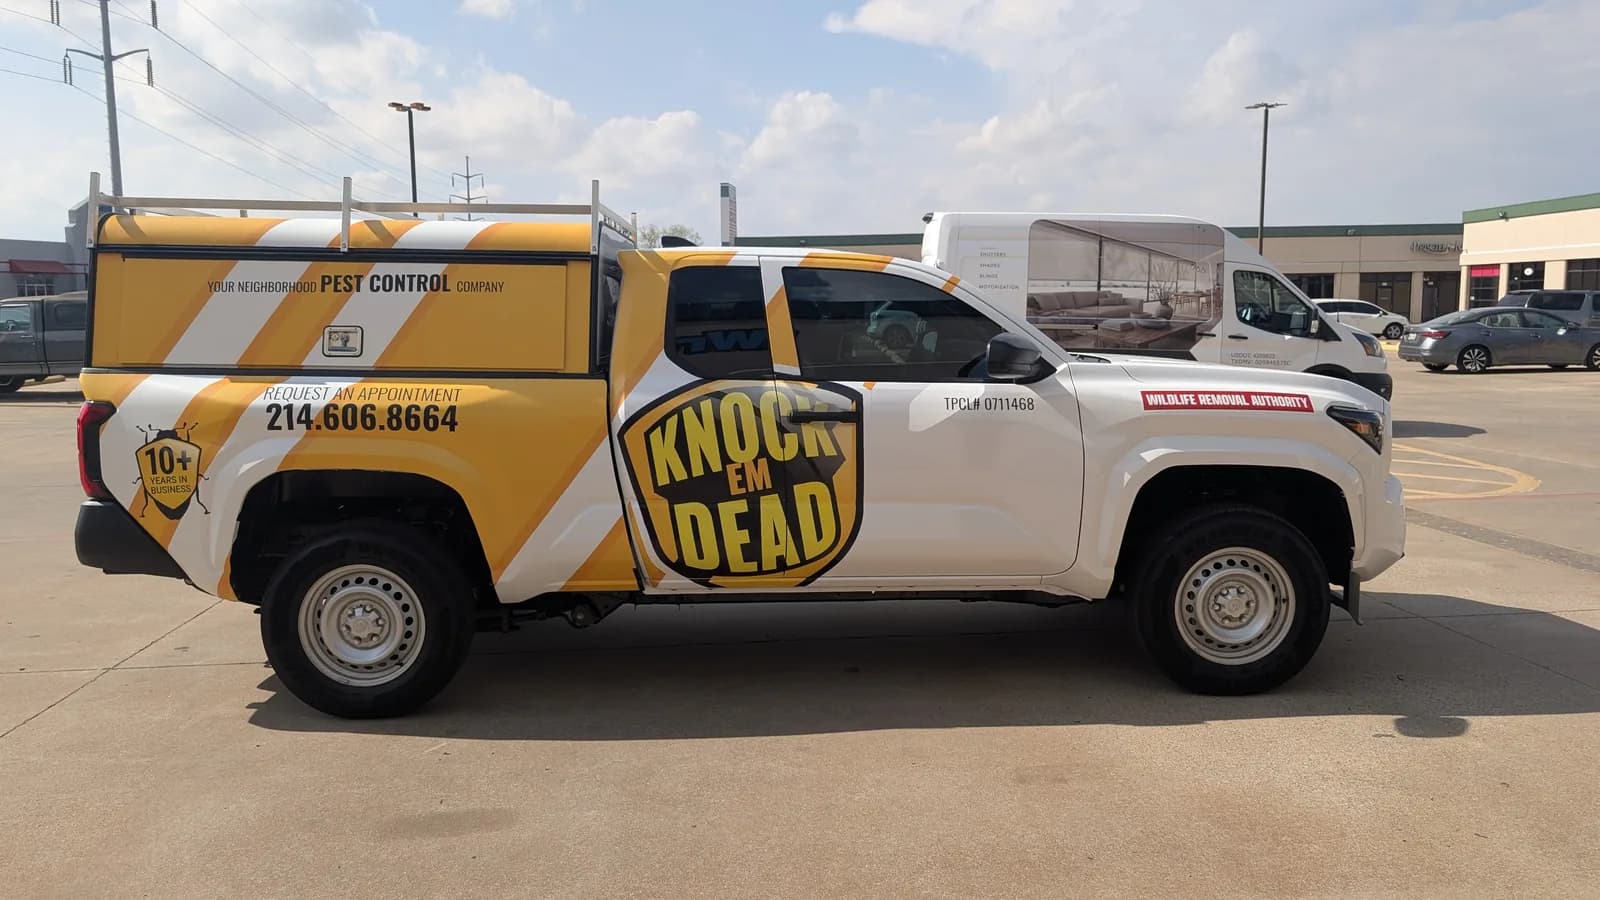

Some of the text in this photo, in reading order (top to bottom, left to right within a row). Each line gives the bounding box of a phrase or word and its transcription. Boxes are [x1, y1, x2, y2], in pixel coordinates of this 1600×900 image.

[208, 274, 505, 293] YOUR NEIGHBORHOOD PEST CONTROL COMPANY
[263, 386, 463, 402] REQUEST AN APPOINTMENT
[1146, 393, 1309, 409] WILDLIFE REMOVAL AUTHORITY
[944, 397, 1035, 411] TPCL# 0711468
[266, 403, 458, 432] 214.606.8664
[649, 390, 838, 487] KNOCK
[145, 446, 192, 475] 10+
[150, 475, 188, 485] YEARS IN
[726, 457, 773, 496] EM
[150, 485, 192, 495] BUSINESS
[673, 481, 837, 573] DEAD
